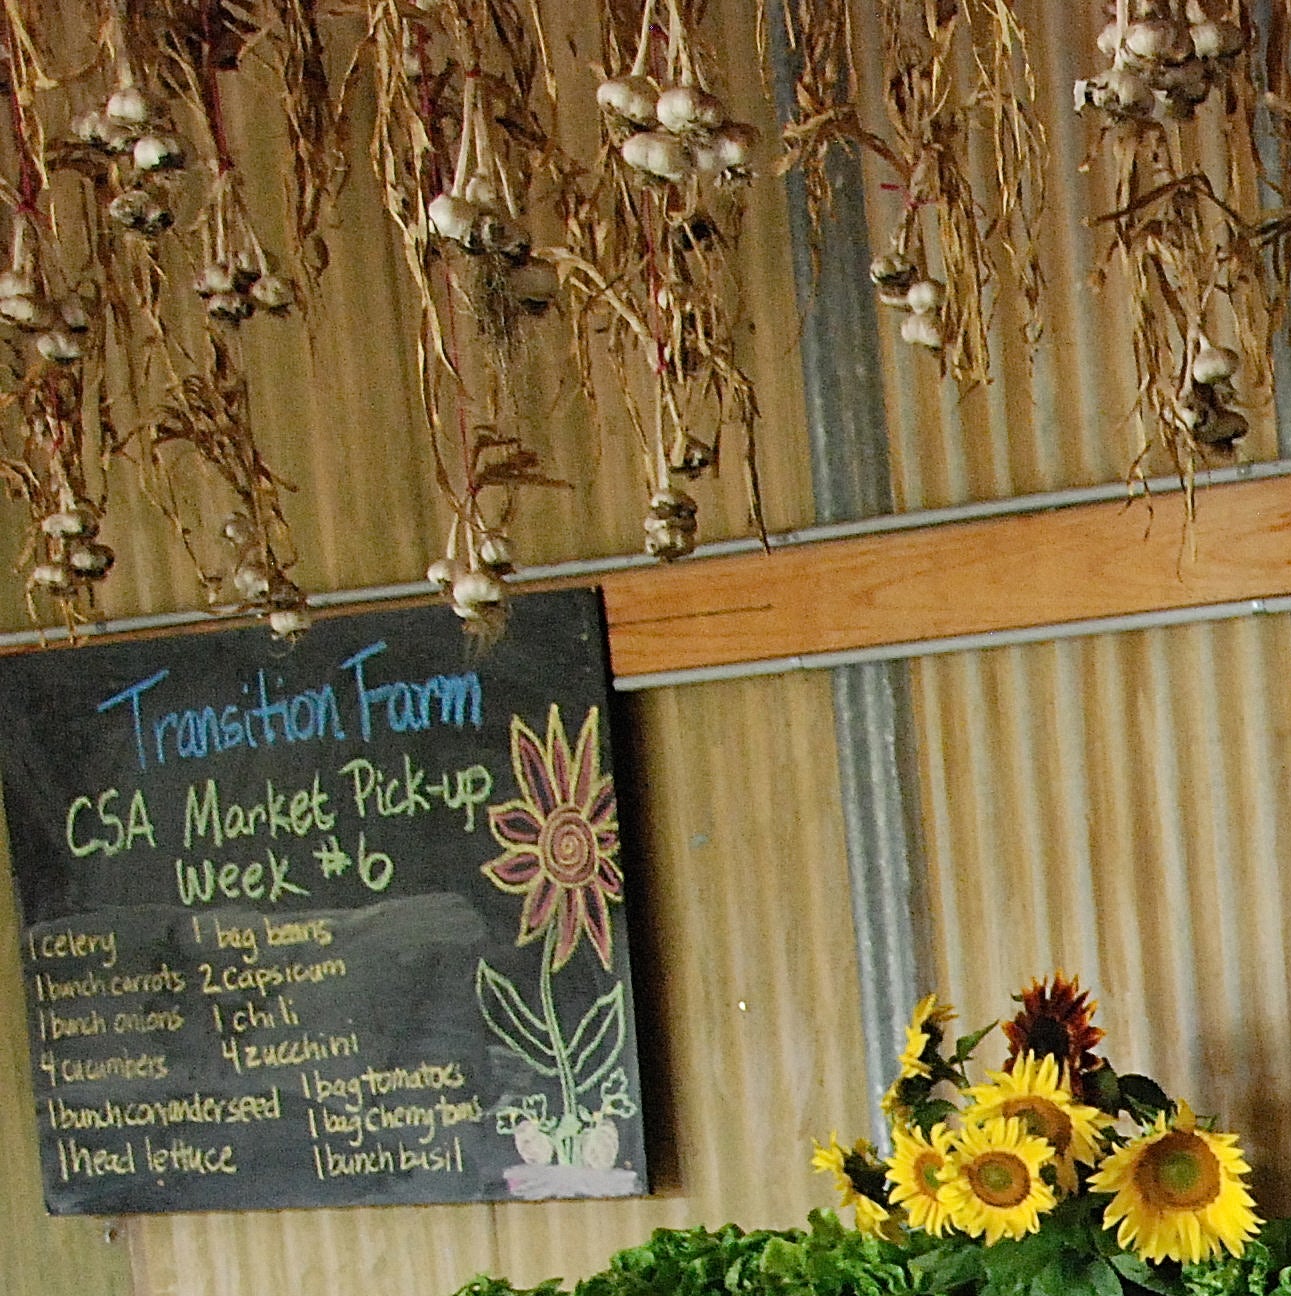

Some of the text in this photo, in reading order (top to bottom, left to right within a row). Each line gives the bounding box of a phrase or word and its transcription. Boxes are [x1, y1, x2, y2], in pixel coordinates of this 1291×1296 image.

[97, 641, 482, 769] Transition Farm
[65, 754, 493, 858] CSA Market Pick-up
[314, 837, 396, 893] #6
[42, 928, 117, 967] celery
[214, 917, 259, 965] bag
[198, 963, 223, 994] 2
[221, 1031, 359, 1074] 4 zucchini
[313, 1070, 363, 1113] bag
[323, 1106, 364, 1148] bag
[69, 1137, 136, 1177] head
[144, 1136, 238, 1174] lettuce
[325, 1142, 395, 1177] bunch
